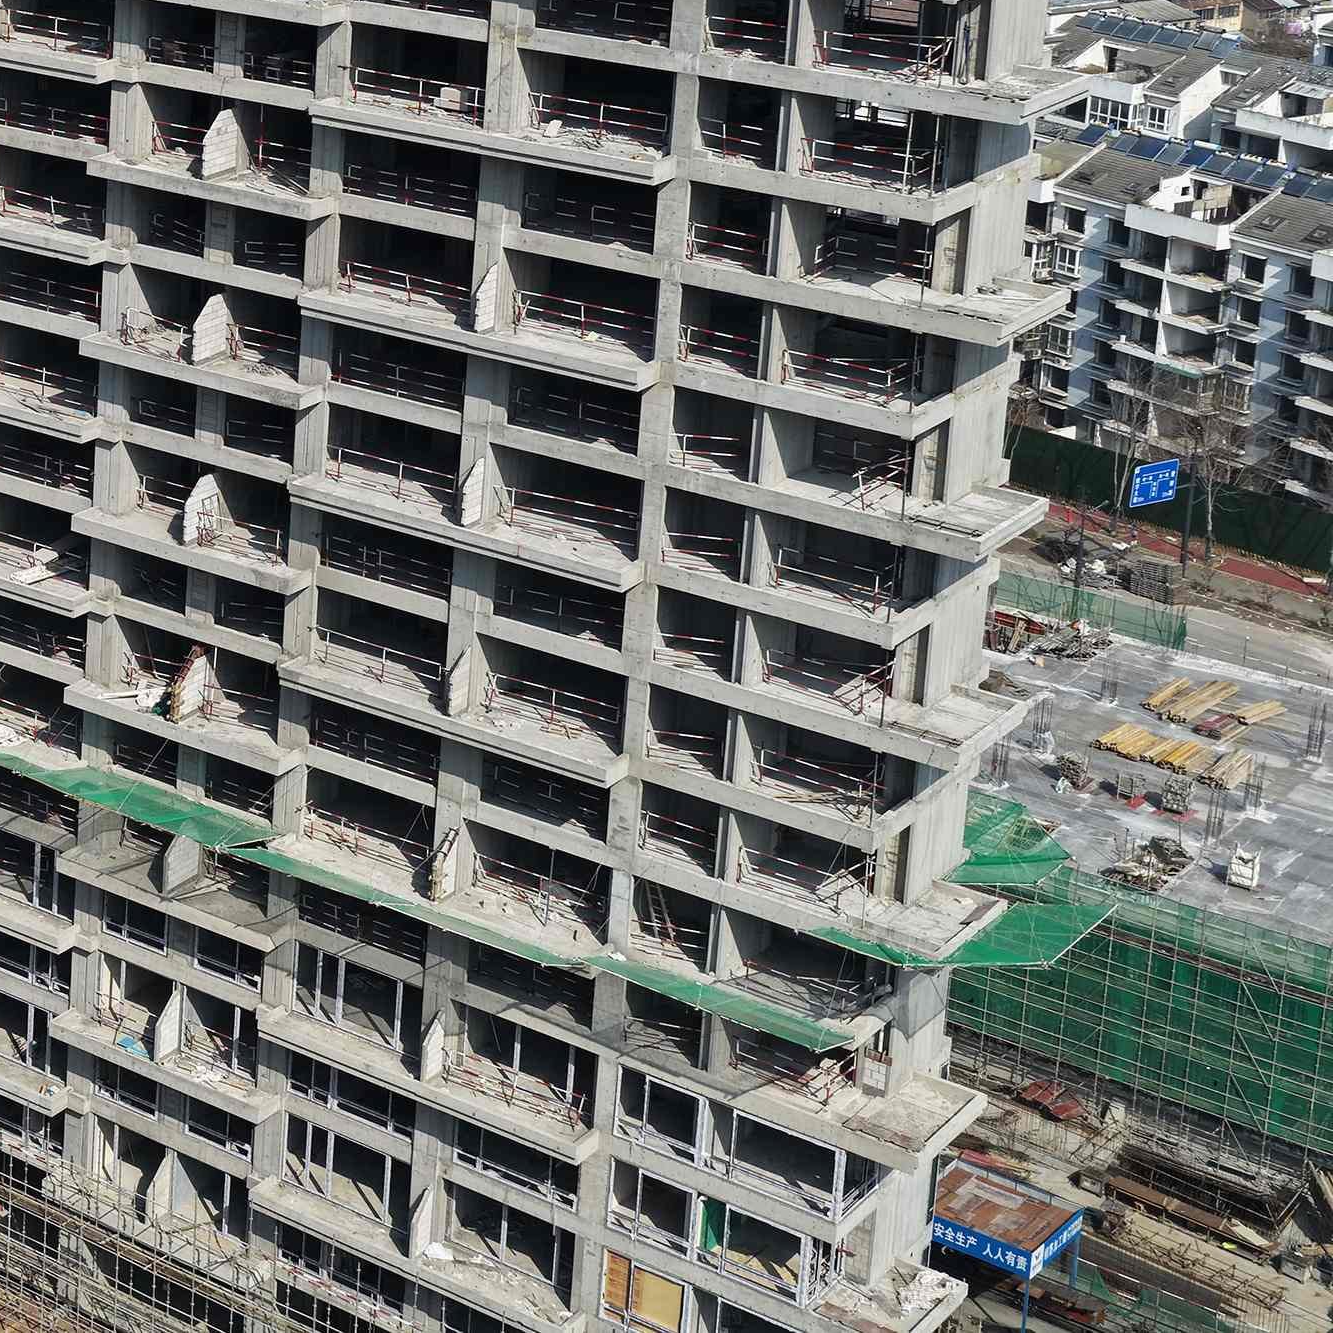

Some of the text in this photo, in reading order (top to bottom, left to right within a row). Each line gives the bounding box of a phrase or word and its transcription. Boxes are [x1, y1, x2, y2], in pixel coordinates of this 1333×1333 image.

[933, 1222, 978, 1249] 安全生产
[982, 1242, 1028, 1272] 人人有责
